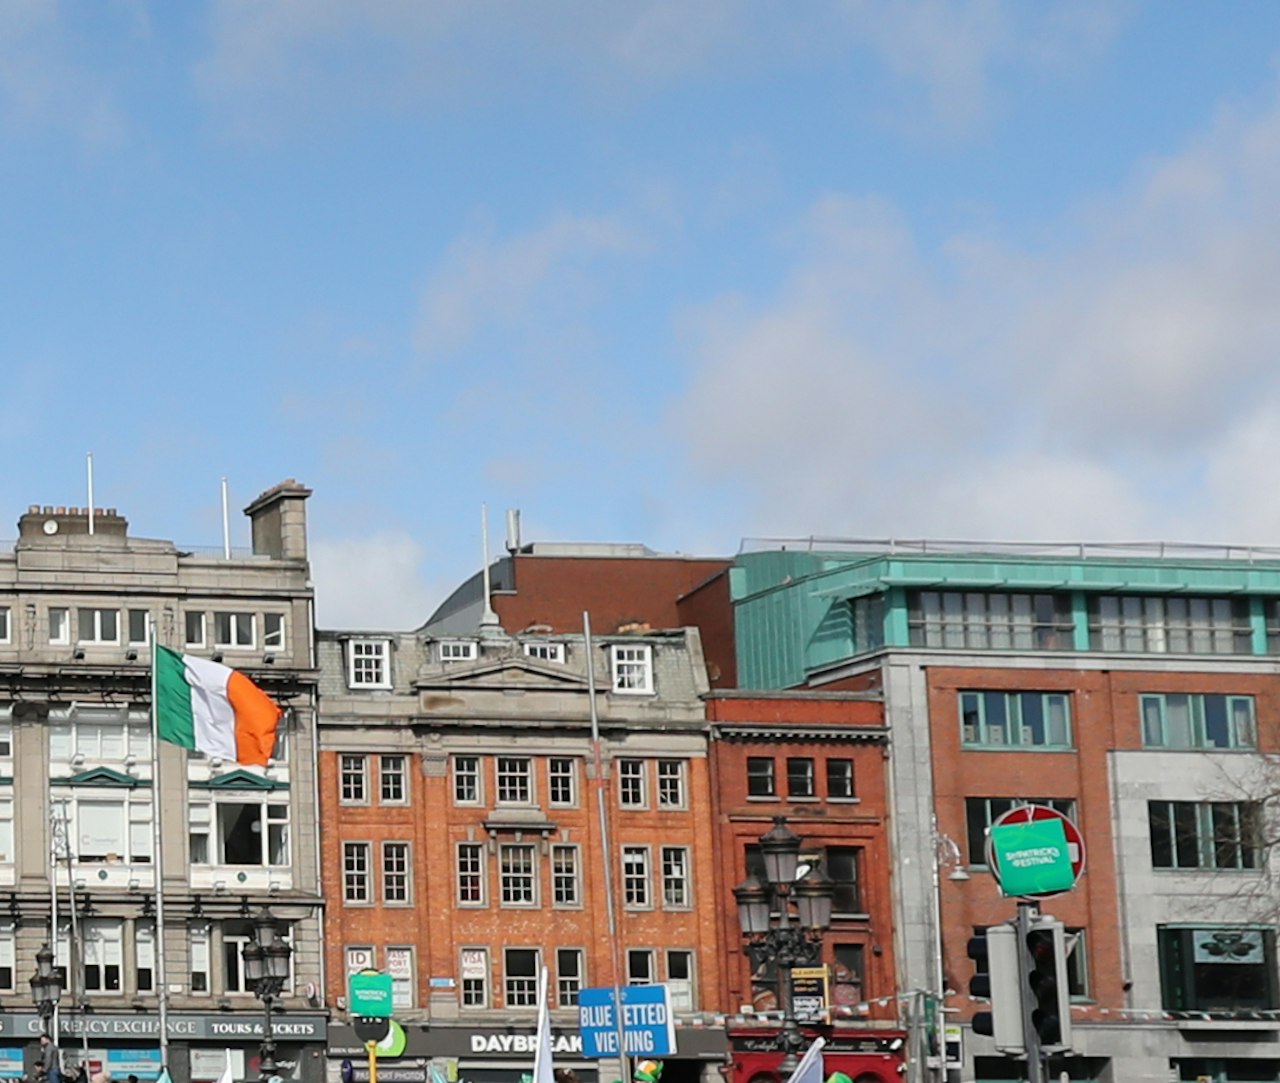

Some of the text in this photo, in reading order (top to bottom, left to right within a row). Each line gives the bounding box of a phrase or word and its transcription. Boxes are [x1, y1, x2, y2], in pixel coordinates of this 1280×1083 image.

[350, 952, 367, 965] ID
[463, 951, 483, 964] VISA
[580, 1003, 666, 1027] BLUE ETTED
[28, 1020, 197, 1034] CURENCY EXCHANGE
[211, 1022, 252, 1034] TOURS
[253, 1023, 263, 1034] &
[594, 1030, 654, 1053] VIEWING
[355, 1070, 392, 1080] PASORT
